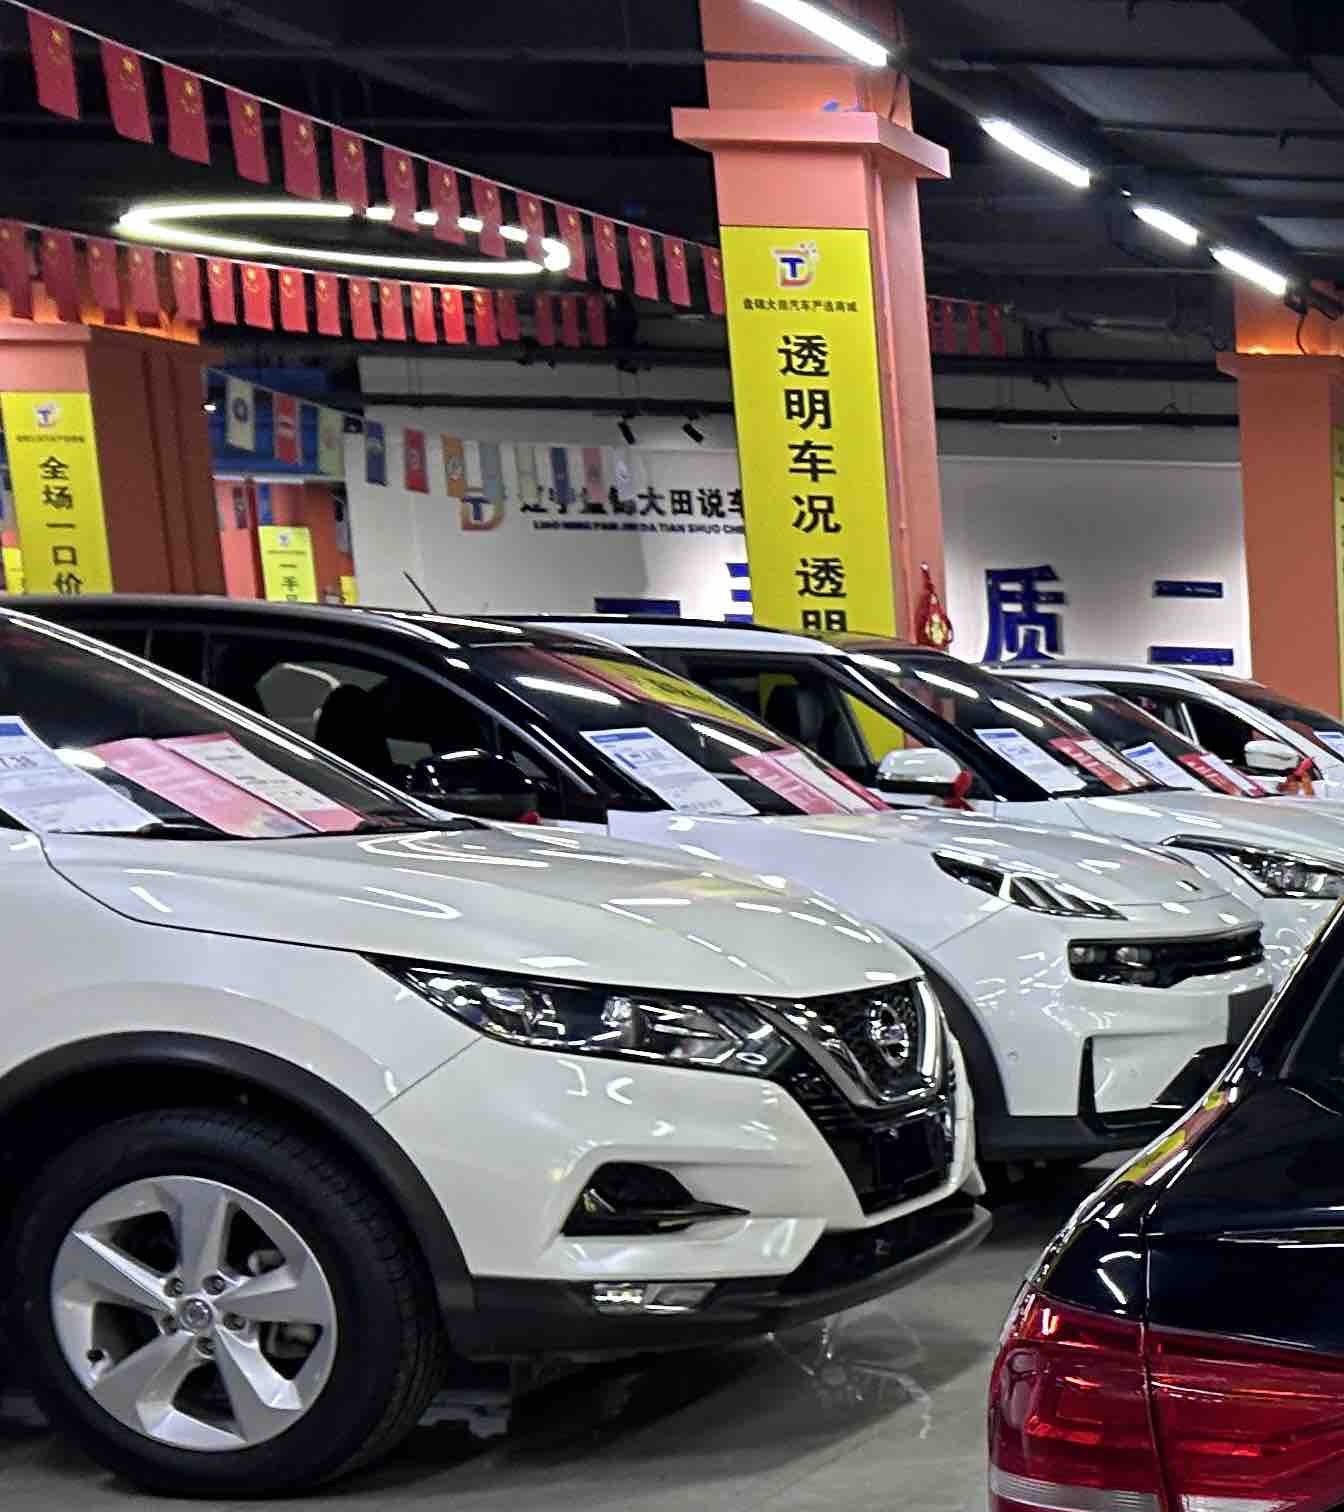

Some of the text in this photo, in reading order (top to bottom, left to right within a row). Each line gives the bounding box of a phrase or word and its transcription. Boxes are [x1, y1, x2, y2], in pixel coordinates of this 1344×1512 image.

[777, 334, 842, 534] 透明车况
[39, 456, 84, 594] 全场一口价
